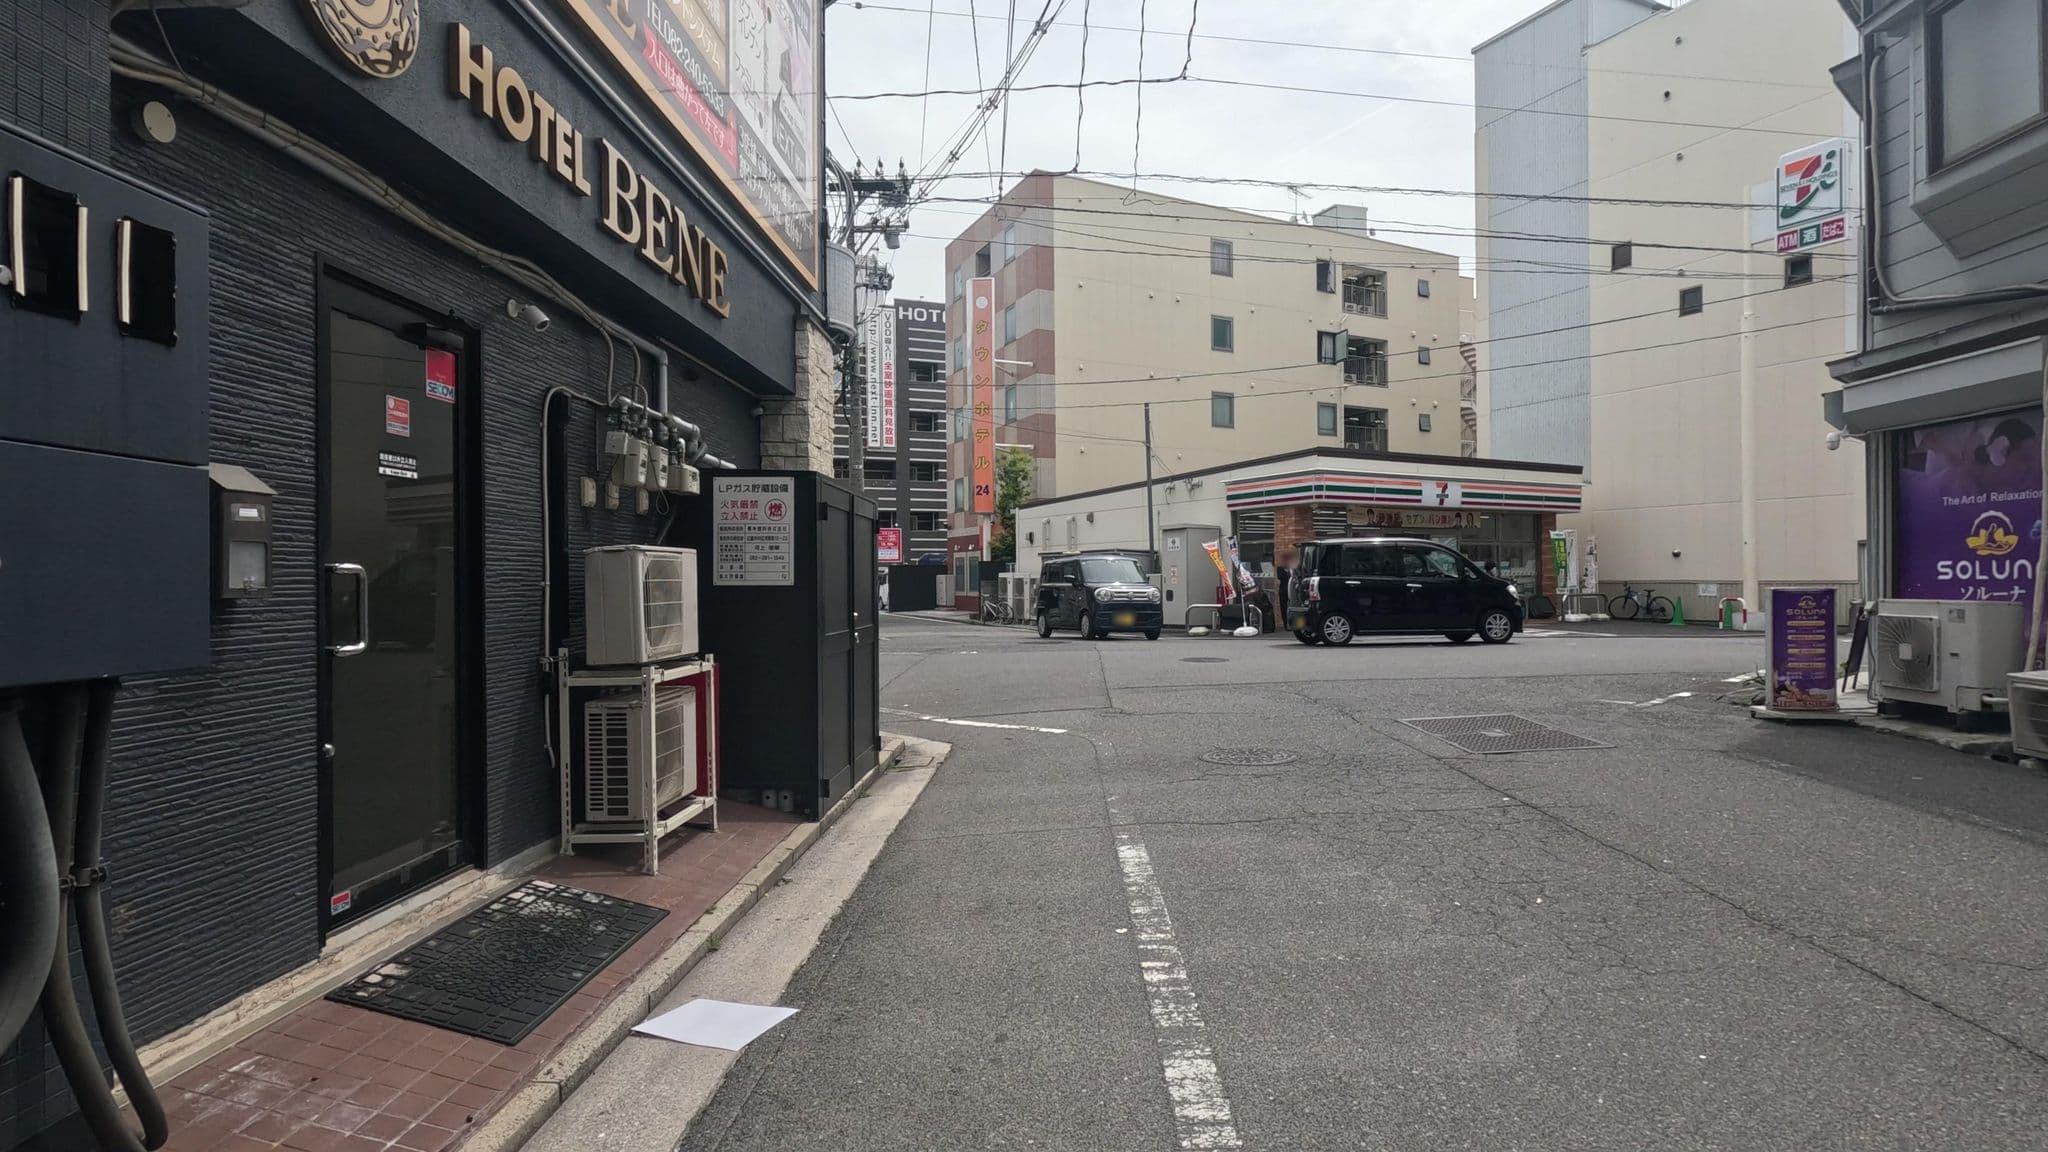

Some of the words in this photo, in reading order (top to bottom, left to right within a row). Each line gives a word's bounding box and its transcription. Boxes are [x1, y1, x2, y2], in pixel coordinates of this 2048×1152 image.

[455, 21, 592, 198] HOTEL
[600, 137, 731, 319] BENE
[1777, 232, 1799, 249] ATM
[1802, 227, 1817, 244] 酒
[974, 319, 991, 470] タウンホテル
[718, 483, 789, 493] LPガス貯蔵設備
[975, 484, 991, 497] 24
[720, 500, 759, 509] 火気厳禁
[1942, 496, 1960, 506] The
[1960, 495, 1976, 504] Art
[1976, 492, 1987, 503] of
[720, 511, 759, 521] 立入禁止
[767, 502, 783, 518] 燃
[1937, 558, 2036, 580] SOLUN
[1960, 585, 2027, 601] ソルーナ
